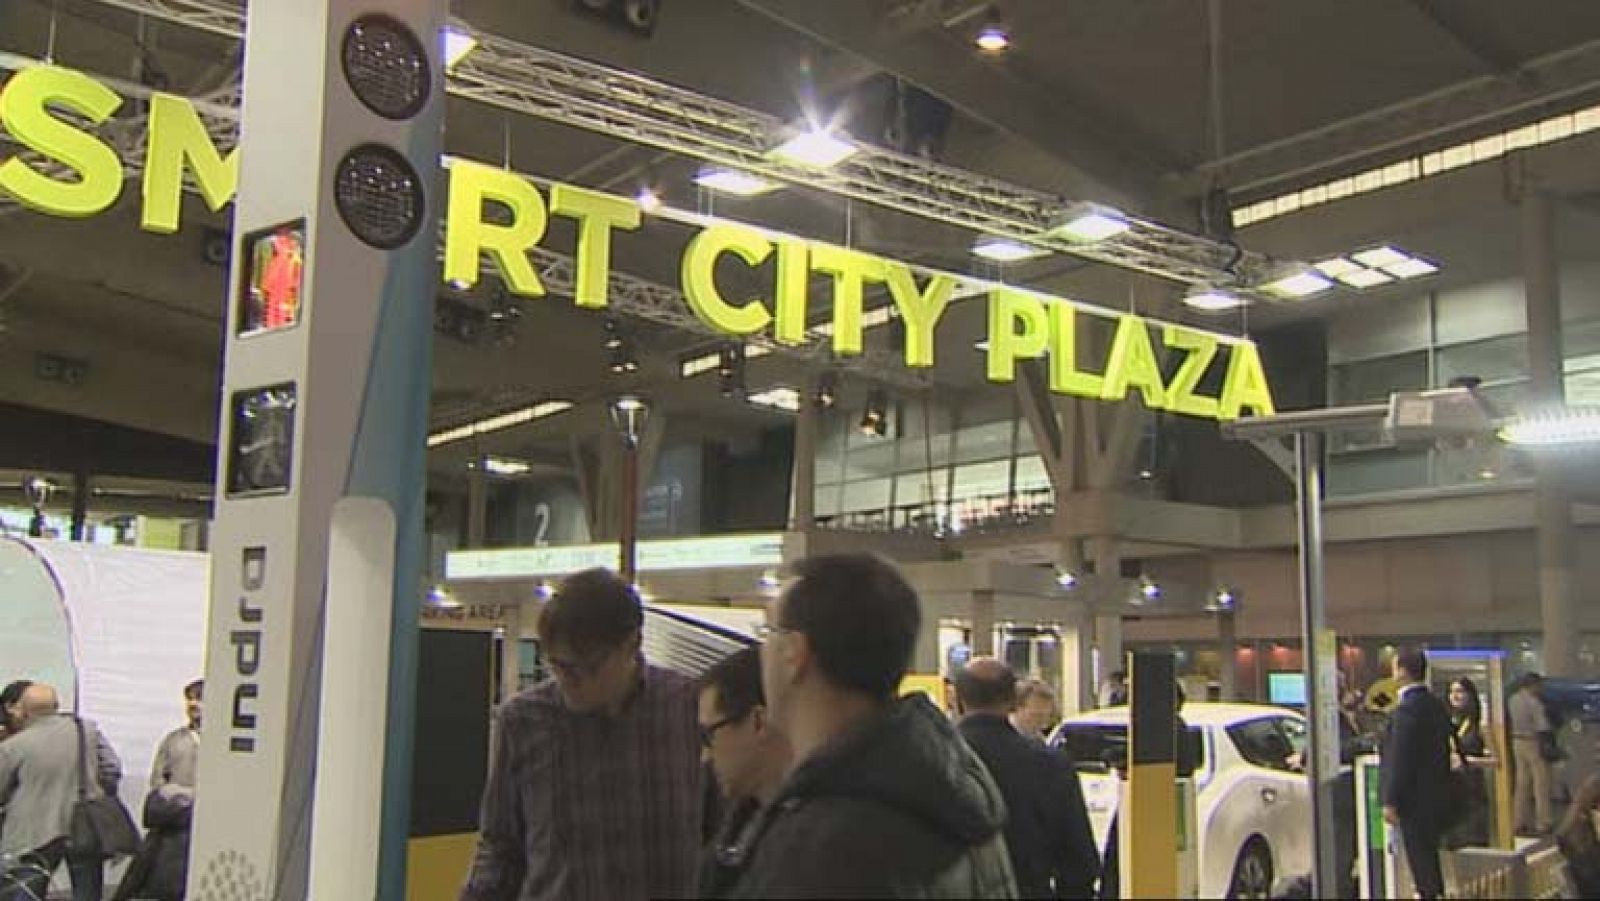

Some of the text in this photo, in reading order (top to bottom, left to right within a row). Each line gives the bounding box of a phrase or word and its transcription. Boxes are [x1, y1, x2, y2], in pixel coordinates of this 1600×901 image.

[0, 65, 1274, 421] SMRT CITY PLAZA
[535, 503, 551, 546] 2
